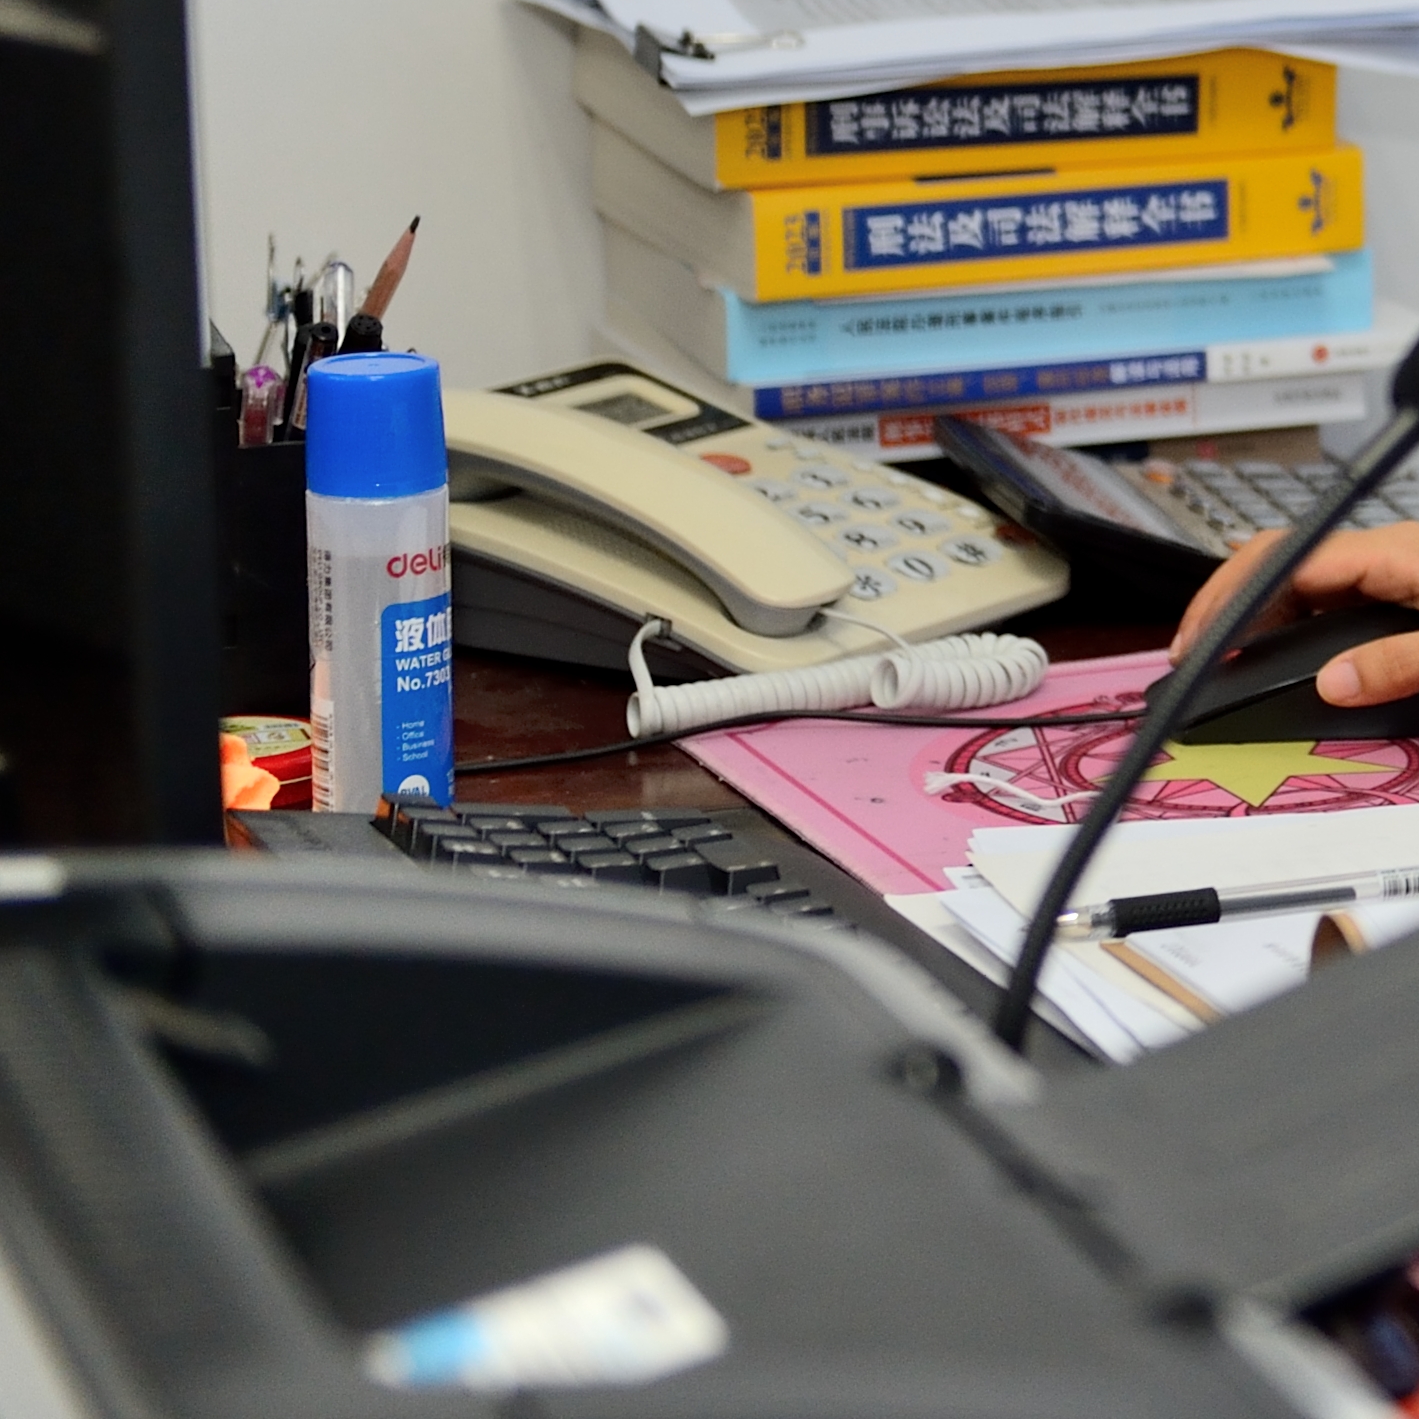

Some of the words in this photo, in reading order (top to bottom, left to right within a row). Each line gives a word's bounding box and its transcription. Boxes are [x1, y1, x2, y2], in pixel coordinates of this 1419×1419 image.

[829, 84, 1191, 146] 刑事诉讼法及司法解释全书
[866, 190, 1217, 257] 刑法及司法解释全书
[386, 545, 442, 579] deli
[395, 651, 442, 672] WATER
[402, 720, 425, 730] Home
[402, 731, 425, 741] Office
[402, 739, 435, 752] Business
[402, 750, 429, 762] School
